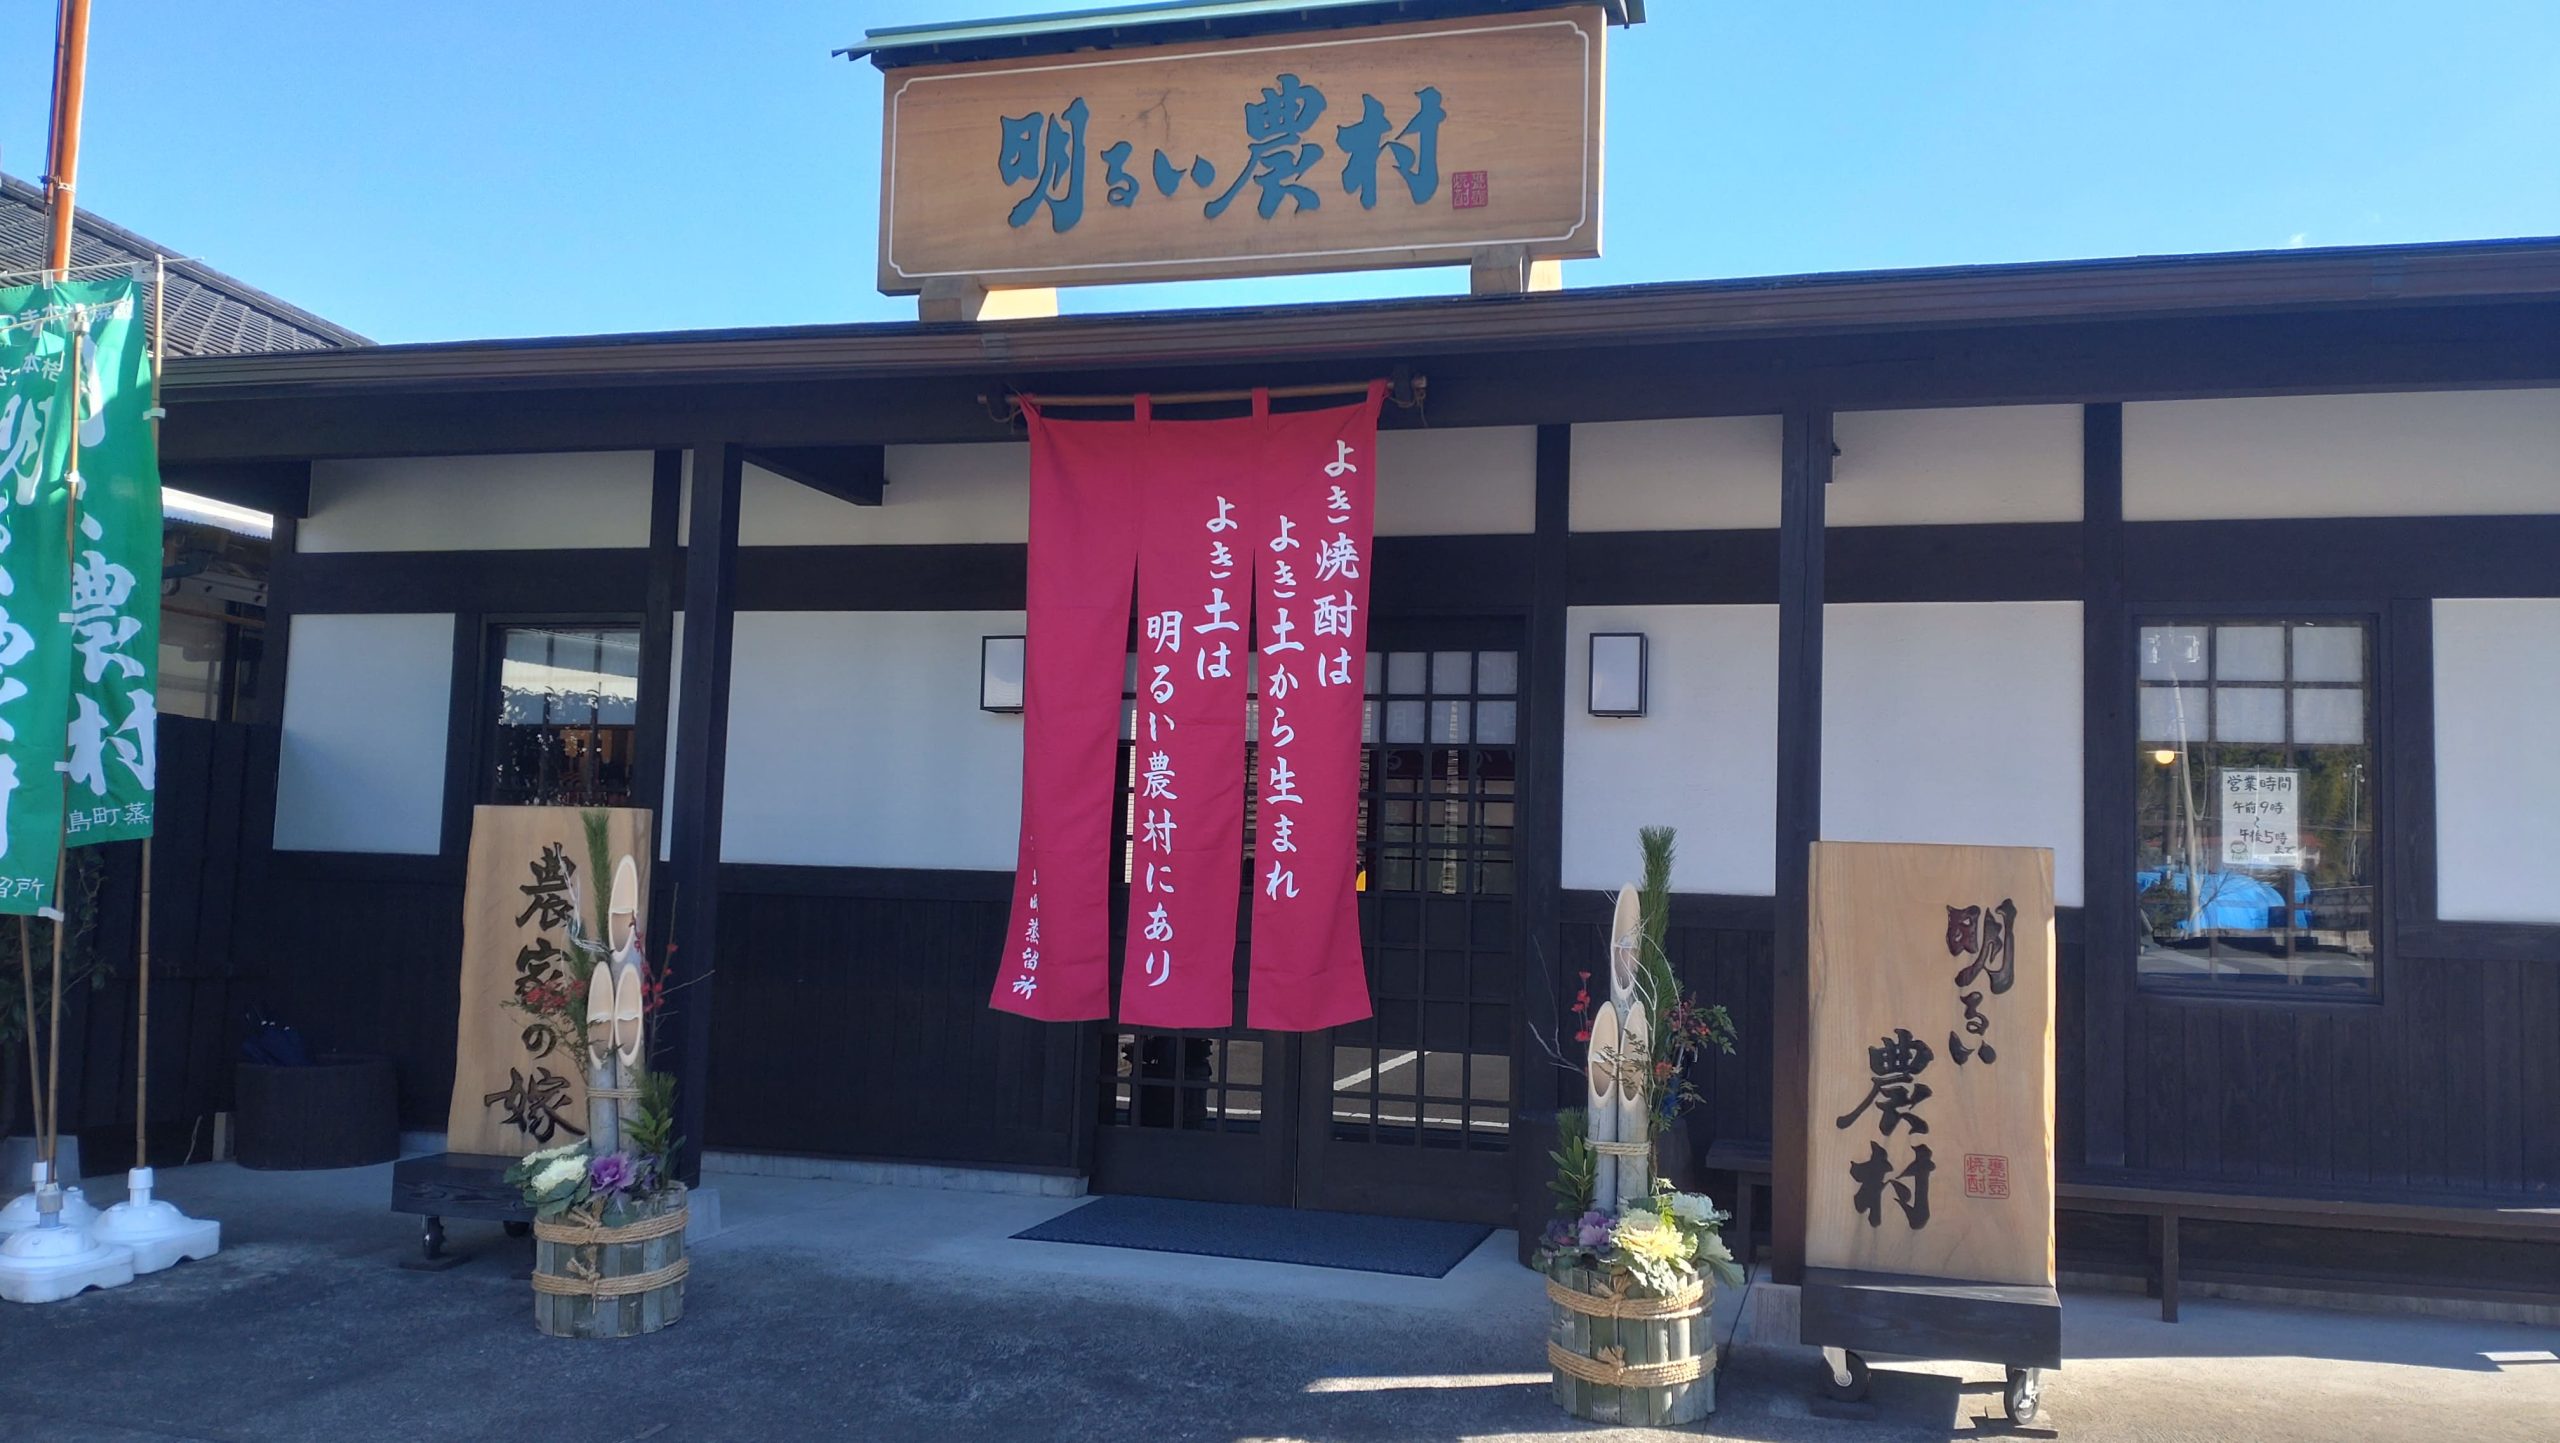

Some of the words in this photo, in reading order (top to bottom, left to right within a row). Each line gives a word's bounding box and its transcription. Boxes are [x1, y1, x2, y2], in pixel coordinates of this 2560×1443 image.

[999, 73, 1447, 233] 明るい農村
[1193, 495, 1240, 681] よき土は
[1313, 439, 1361, 687] よき焼酎は
[1141, 609, 1184, 988] 明るい農村にあり
[1262, 514, 1305, 902] よき土から生まれ
[2226, 774, 2292, 792] 営業時間
[2232, 801, 2285, 815] 午前9時
[2239, 828, 2289, 845] 午後5時
[484, 841, 587, 1144] 農家の嫁
[1946, 897, 2018, 1066] 明るい
[1835, 1028, 1937, 1231] 農村
